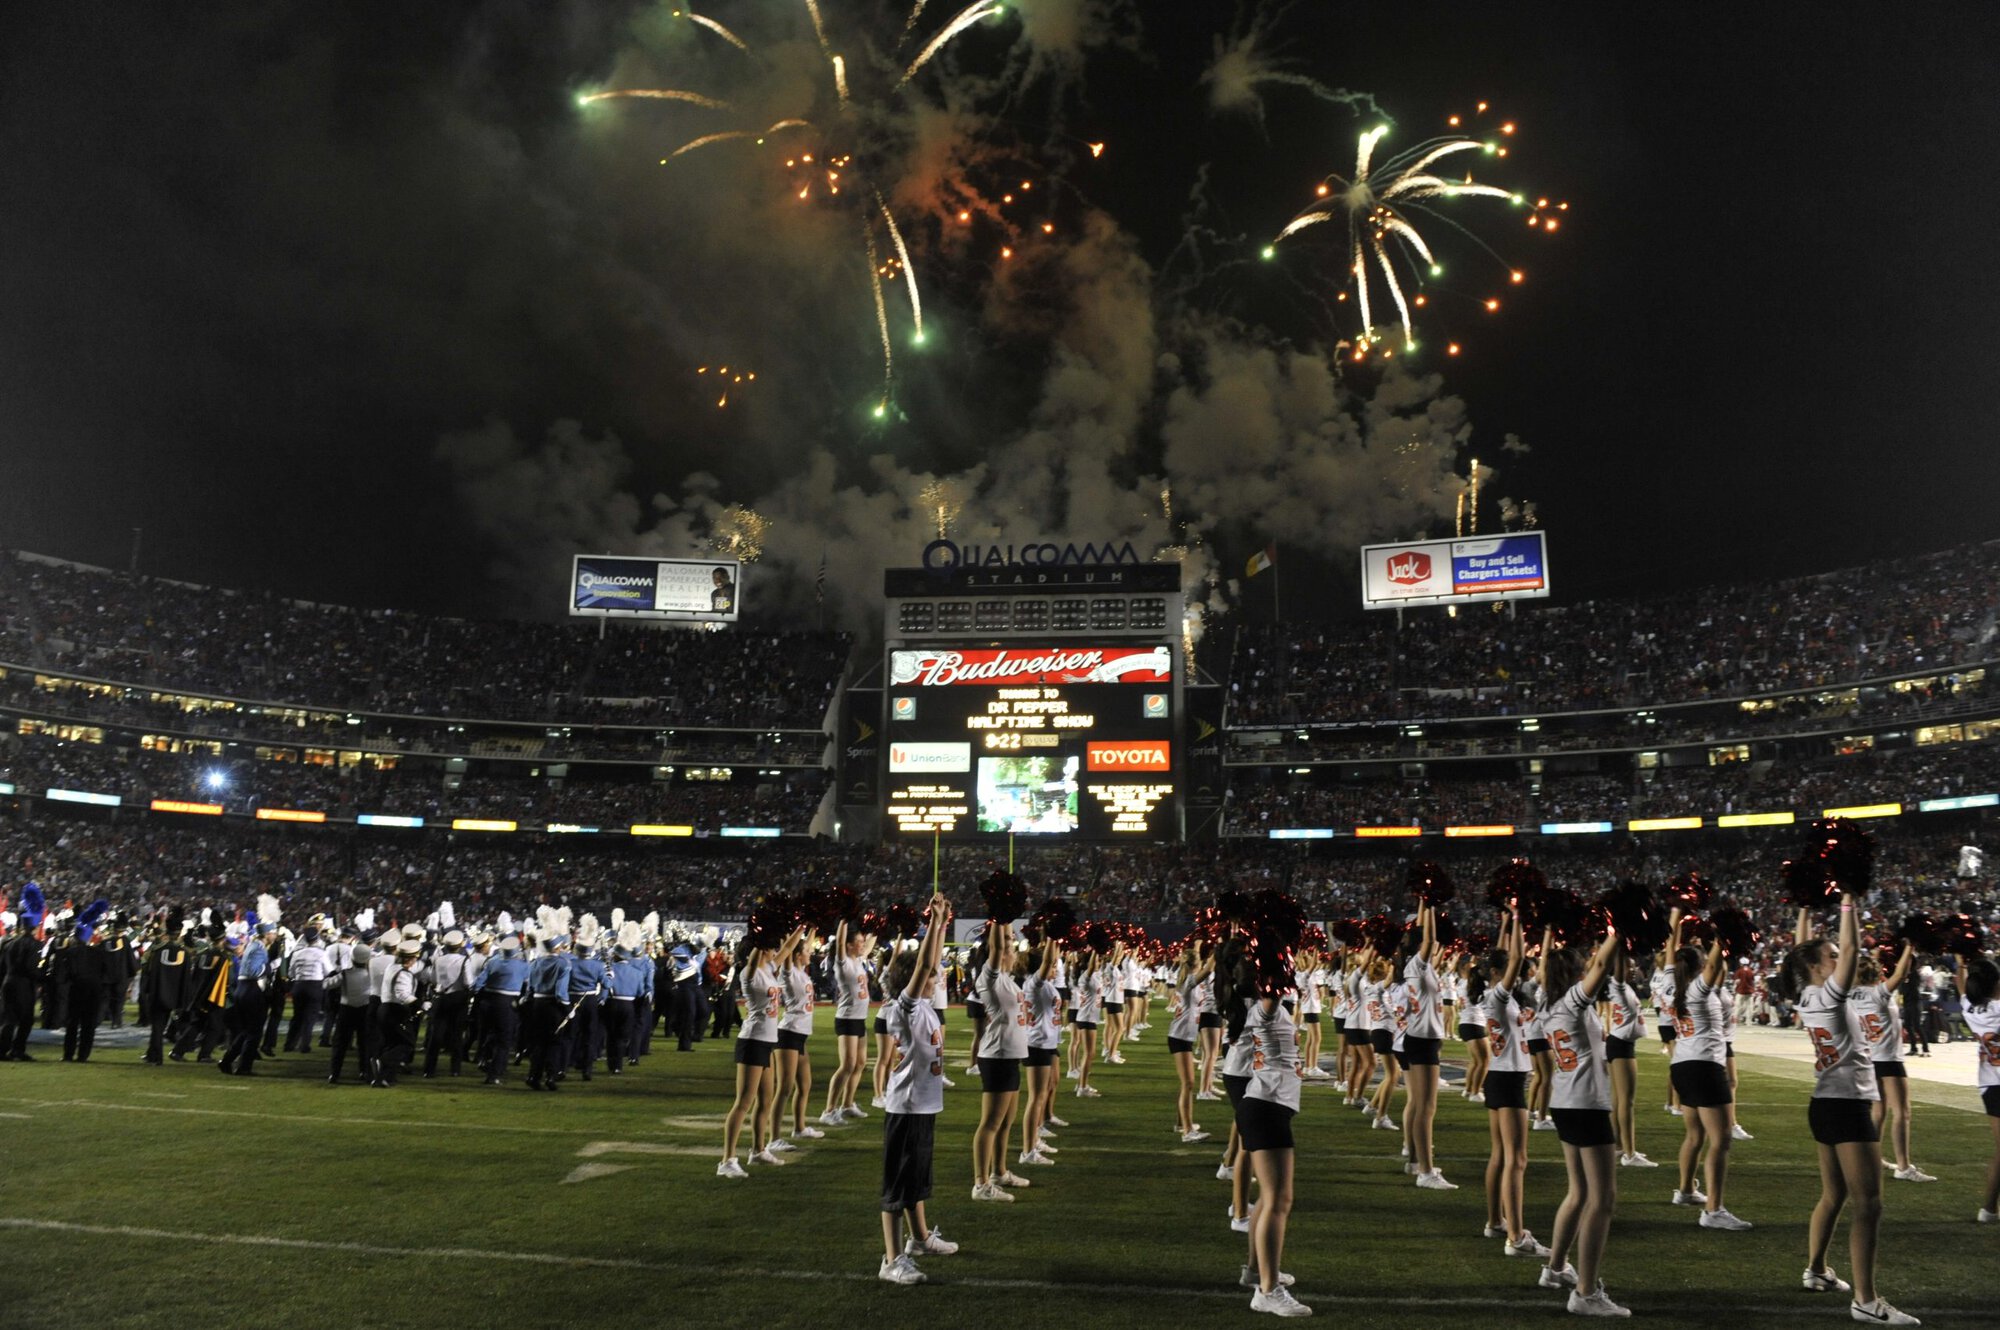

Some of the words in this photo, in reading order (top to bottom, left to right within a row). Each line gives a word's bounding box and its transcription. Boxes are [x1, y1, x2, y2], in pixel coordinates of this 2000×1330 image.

[922, 539, 1139, 576] QUALCOMM
[1469, 558, 1486, 569] Buy
[1488, 557, 1505, 566] and
[1507, 555, 1524, 565] Sell
[1389, 555, 1430, 581] Jack
[1459, 569, 1500, 580] Chargers
[1501, 565, 1537, 577] Tickets!
[580, 573, 653, 588] QUALCOMM
[967, 573, 1123, 585] STADIUM
[660, 584, 711, 593] HEALTH
[917, 648, 1103, 685] Budweiser
[1043, 689, 1059, 699] TO
[988, 702, 1009, 714] DR
[1013, 701, 1068, 713] PEPPER
[967, 716, 1045, 728] HALFTIME
[1053, 715, 1094, 728] SHOW
[1090, 749, 1166, 765] TOYOTA
[160, 949, 185, 966] U
